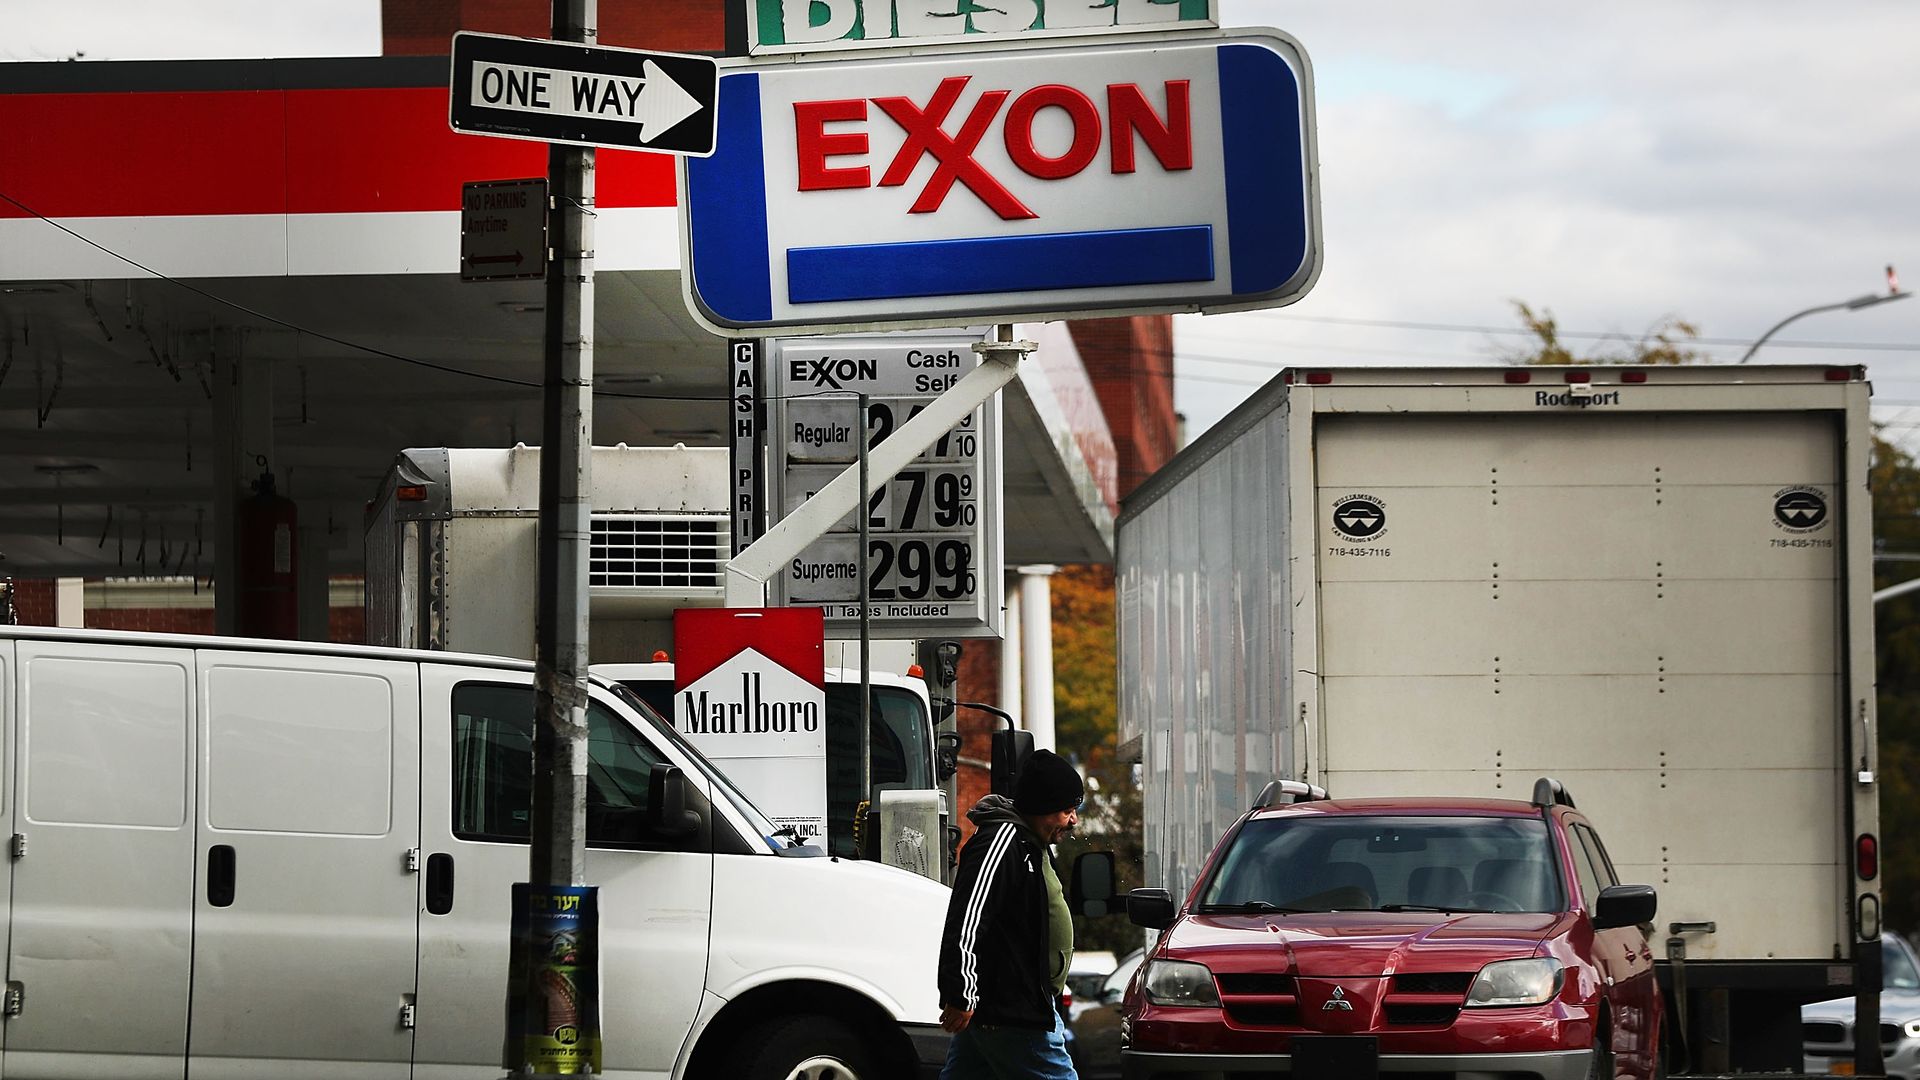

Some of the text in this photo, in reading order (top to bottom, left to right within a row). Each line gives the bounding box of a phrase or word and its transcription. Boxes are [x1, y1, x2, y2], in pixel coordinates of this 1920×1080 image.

[481, 67, 645, 117] ONE WAY
[792, 75, 1192, 220] EXXON
[467, 191, 527, 211] NO PARKING
[467, 215, 508, 237] Anytime
[906, 350, 960, 368] Cash
[789, 356, 878, 390] EXXON
[915, 374, 958, 393] Self
[737, 344, 752, 438] CASH
[794, 422, 851, 447] Regular
[956, 434, 976, 457] 10
[960, 474, 972, 496] 9
[1332, 494, 1386, 509] WILLIAMSBURG
[1329, 547, 1391, 557] 718-435-7116
[792, 558, 857, 585] Supreme
[868, 539, 966, 600] 299
[887, 604, 949, 617] Included
[683, 672, 818, 734] Marlboro
[799, 824, 822, 836] INCL.
